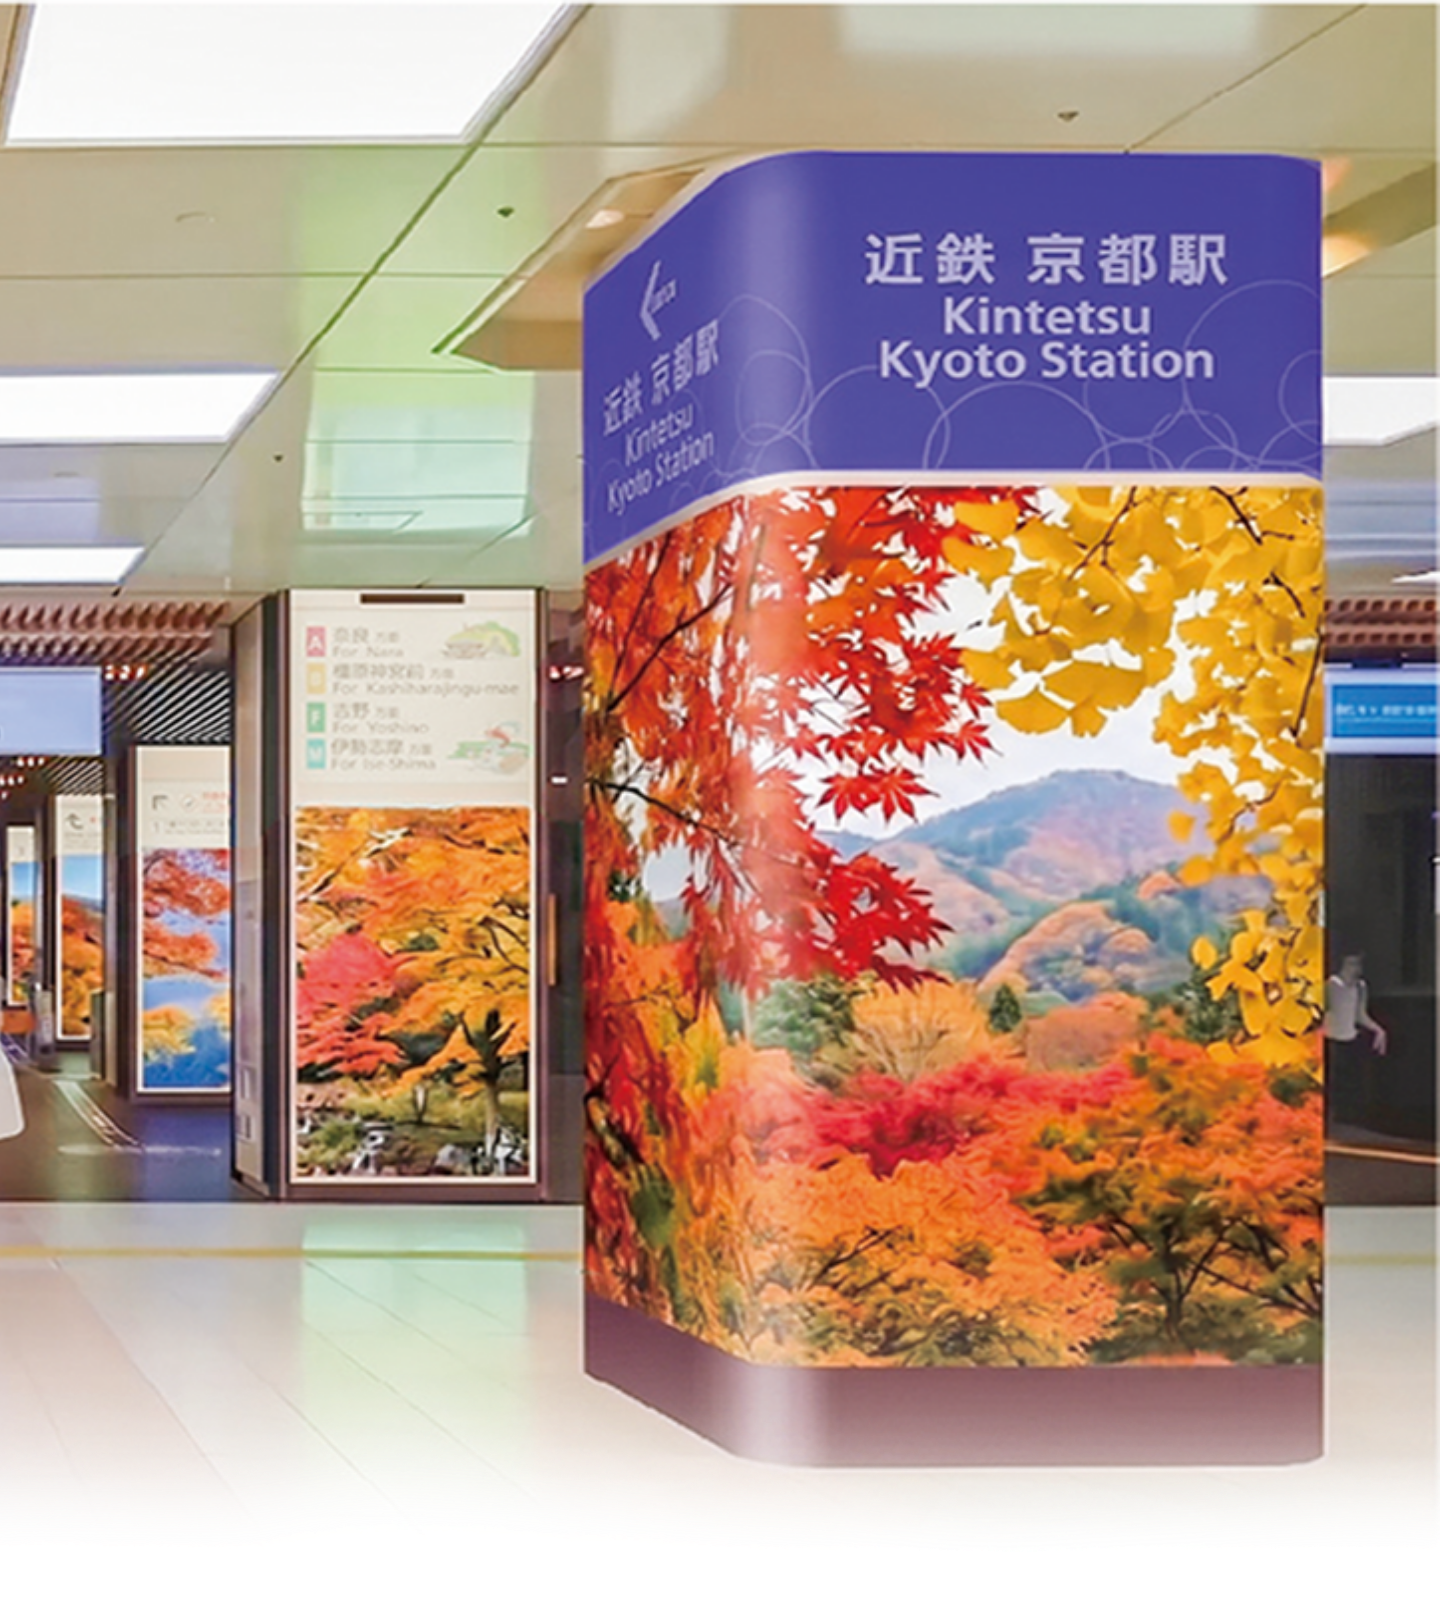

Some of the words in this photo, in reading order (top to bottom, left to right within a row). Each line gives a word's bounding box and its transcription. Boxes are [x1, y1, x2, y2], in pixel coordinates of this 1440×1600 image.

[864, 232, 996, 285] 近鉄
[1026, 232, 1229, 286] 京都駅
[943, 296, 1151, 335] Kintetsu
[603, 371, 643, 436] 近鉄
[651, 319, 719, 405] 京都駅
[879, 339, 1027, 389] Kyoto
[1040, 340, 1214, 379] Station
[624, 403, 693, 466] Kintetsu
[606, 467, 652, 516] Kyoto
[655, 431, 714, 486] Station
[332, 646, 358, 658] For
[332, 681, 358, 695] For
[332, 721, 358, 734] For
[365, 721, 430, 734] Yoshino
[331, 757, 357, 770] For
